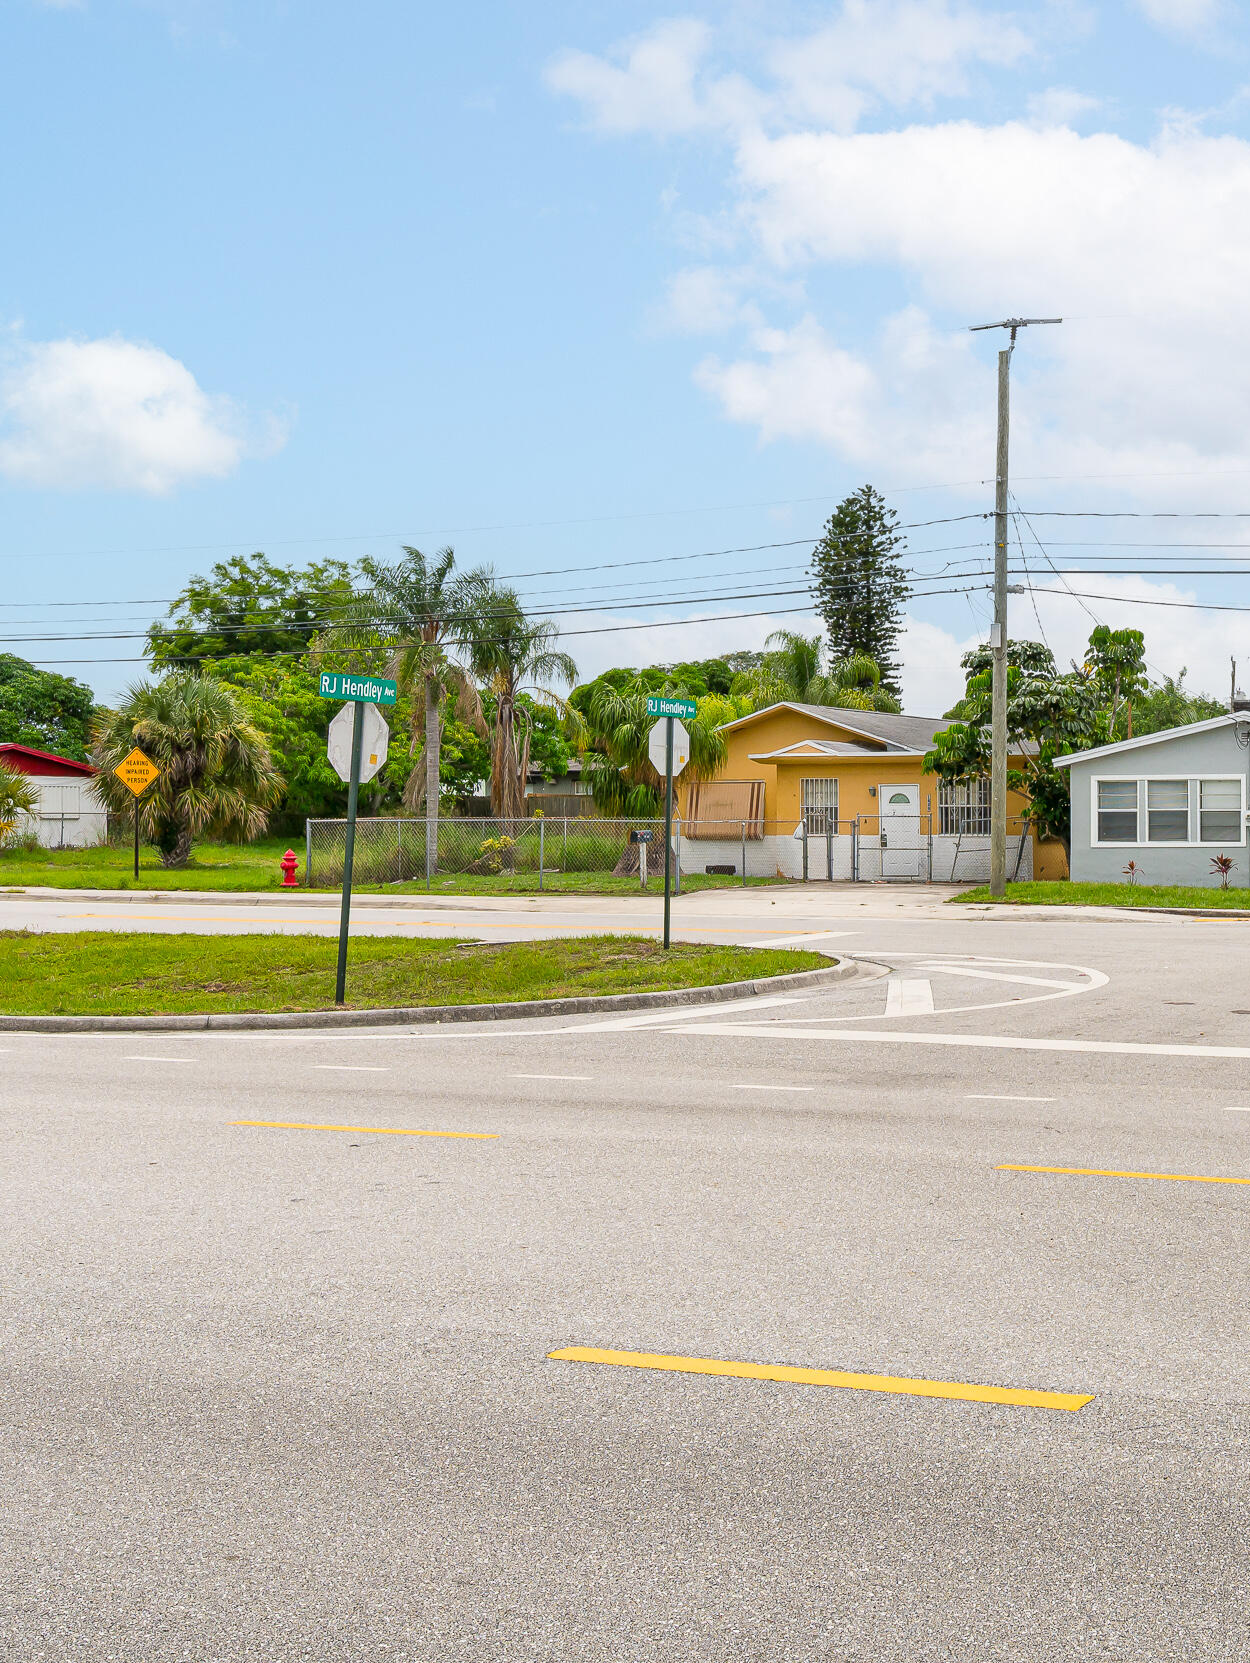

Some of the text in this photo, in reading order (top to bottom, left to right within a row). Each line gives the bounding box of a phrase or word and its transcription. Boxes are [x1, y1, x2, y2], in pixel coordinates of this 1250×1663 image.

[321, 675, 395, 702] RJ Hendley Ave
[648, 699, 658, 712] RJ
[660, 700, 687, 718] Hendley
